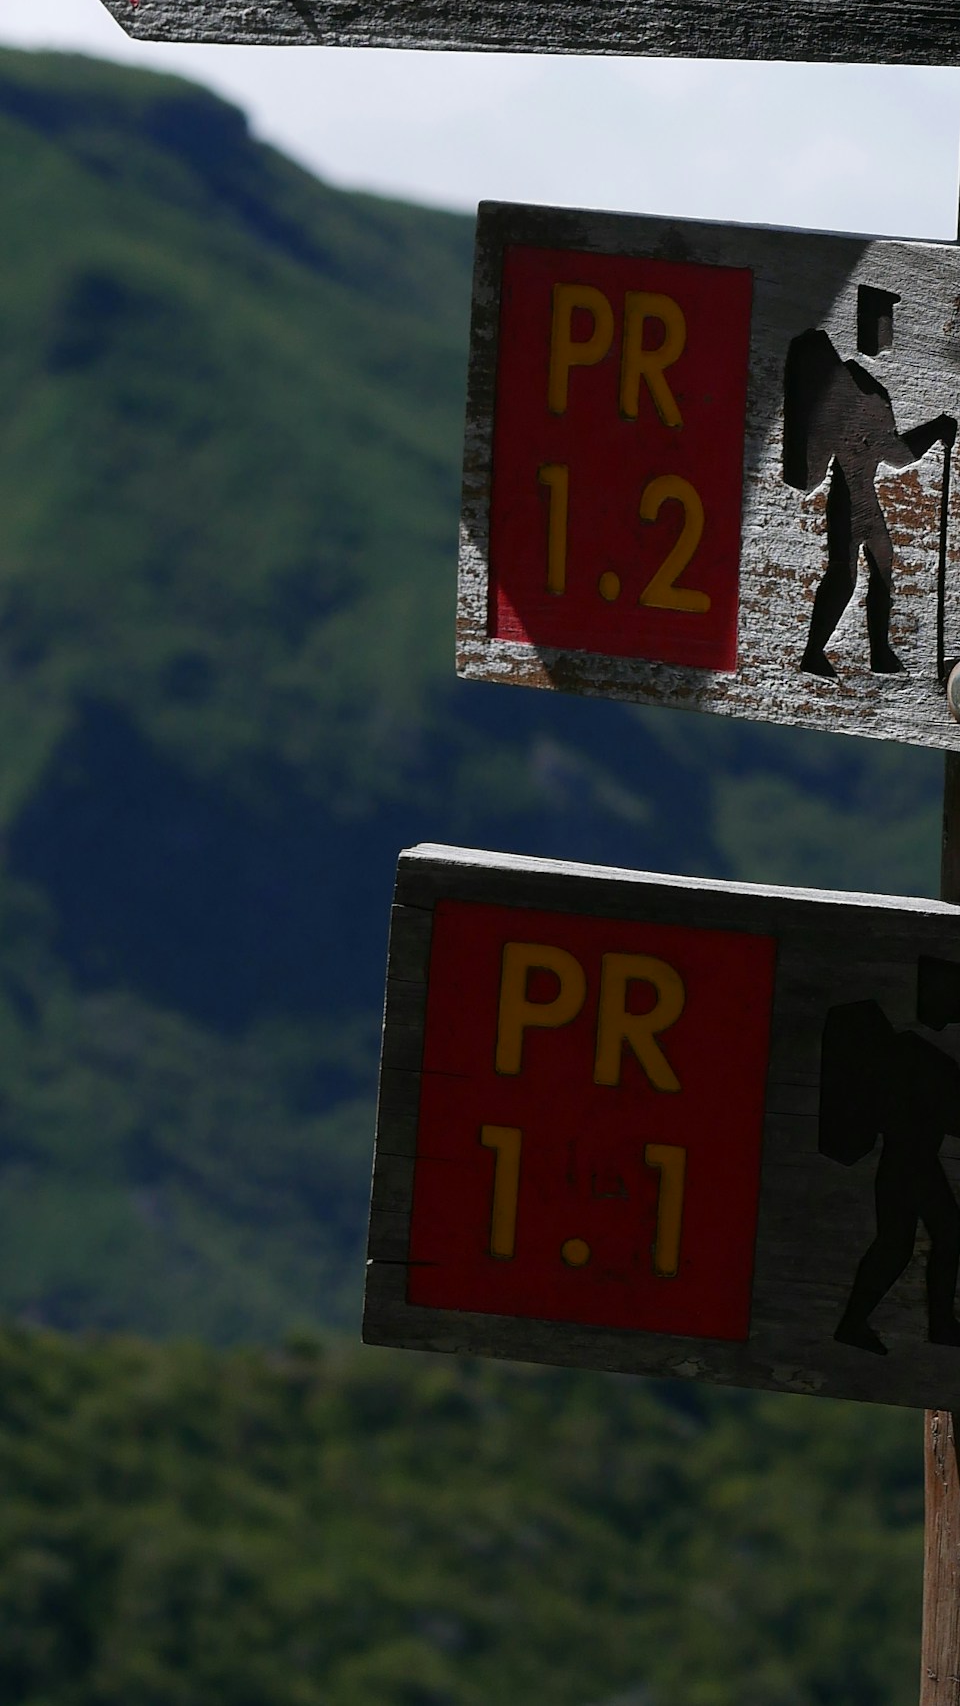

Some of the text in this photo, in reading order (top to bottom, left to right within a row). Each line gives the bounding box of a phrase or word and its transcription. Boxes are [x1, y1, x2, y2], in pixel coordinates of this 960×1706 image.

[548, 283, 687, 427] PR
[537, 463, 710, 612] 1.2
[496, 942, 685, 1092] PR
[480, 1125, 685, 1277] 1.1
